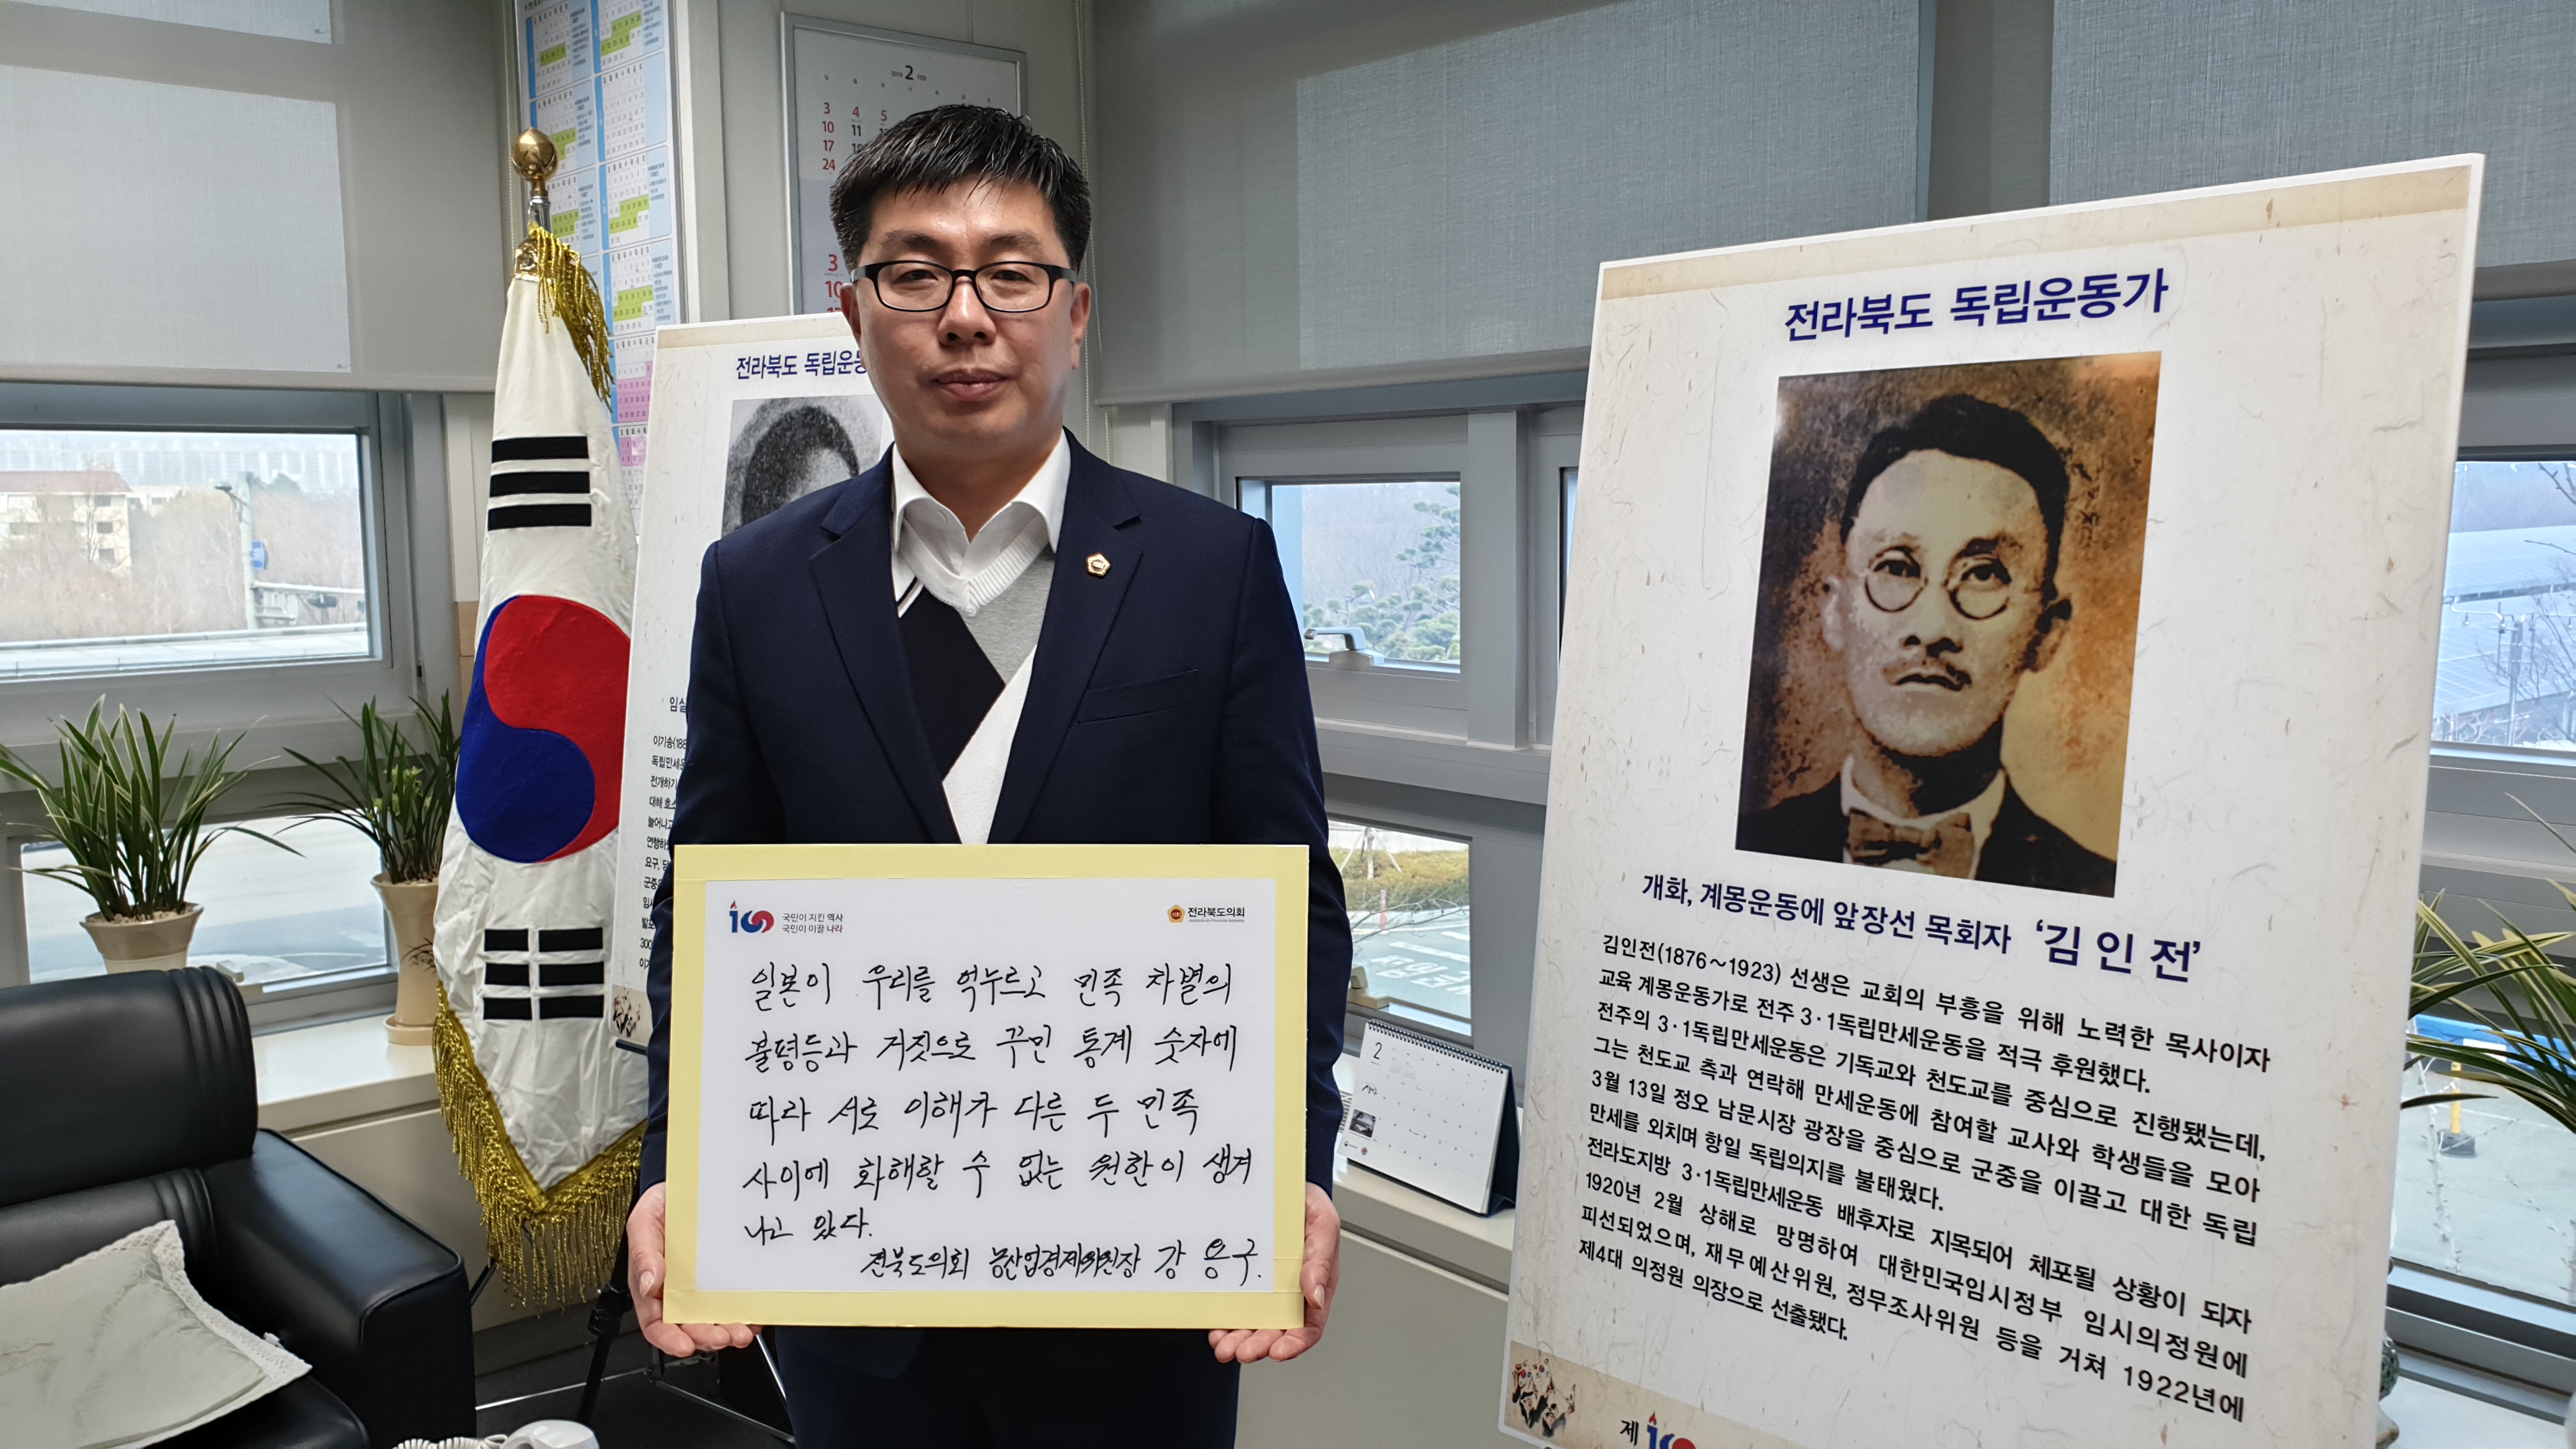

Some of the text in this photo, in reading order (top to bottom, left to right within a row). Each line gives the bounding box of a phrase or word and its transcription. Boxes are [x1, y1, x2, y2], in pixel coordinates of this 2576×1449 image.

[905, 65, 914, 80] 2
[822, 121, 861, 137] 10 11
[824, 102, 887, 121] 3 4 5
[822, 158, 836, 171] 24
[823, 140, 834, 152] 17
[829, 254, 838, 272] 3
[1785, 268, 2170, 342] 전라북도 독립운동가
[736, 354, 797, 380] 전라북도
[650, 797, 663, 809] 대해
[782, 924, 843, 933] 국민이 이끌 나라
[783, 913, 843, 922] 국민이 지킨 역사
[1188, 907, 1245, 917] 전라북도의회
[1642, 875, 1692, 907] 개화,
[1700, 884, 1824, 926] 계몽운동에
[1834, 901, 1915, 939] 앞장선
[1925, 915, 2011, 954] 목회자
[751, 962, 1231, 1012] 일본이 우리를 억누르고 민족 차별의
[1599, 969, 1632, 992] 교육
[1639, 975, 1749, 1014] 계몽운동가로
[1757, 999, 1794, 1023] 전주
[1997, 1044, 2042, 1072] 적극
[2051, 1053, 2150, 1093] 후원했다.
[1790, 968, 1850, 997] 선생은
[1860, 981, 1924, 1011] 교회의
[1936, 993, 2004, 1025] 부흥을
[2018, 1008, 2064, 1036] 위해
[2078, 1018, 2154, 1052] 노력한
[2166, 1032, 2271, 1073] 목사이자
[745, 1024, 1237, 1073] 불평등과 거짓으로 꾸민 통계 숫자에
[1373, 1042, 1382, 1059] 2
[1598, 1002, 1649, 1030] 전주의
[1836, 1052, 1916, 1086] 기독교와
[1926, 1069, 2012, 1107] 천도교를
[2025, 1089, 2117, 1127] 중심으로
[2133, 1111, 2265, 1162] 진행됐는데,
[750, 1088, 1199, 1146] 따라 서로 이해가 다른 두 민족
[1594, 1037, 2260, 1203] 그는 천도교 측과 연락해 만세운동에 참여할 교사와 학생들을 모아
[742, 1144, 1251, 1201] 사이에 화해할 수 없는 원한이 생겨
[1590, 1103, 1943, 1211] 만세를 외치며 항일 독립의지를 불태웠다.
[1592, 1070, 2257, 1246] 3월 13일 정오 남문시장 광장을 중심으로 군중을 이끌고 대한 독립
[744, 1215, 793, 1246] 나고
[1588, 1137, 1671, 1176] 전라도지방
[1837, 1204, 1915, 1241] 배후자로
[1930, 1229, 2012, 1269] 지목되어
[2028, 1254, 2096, 1292] 체포될
[2112, 1276, 2185, 1317] 상황이
[2201, 1300, 2252, 1334] 되자
[860, 1246, 969, 1280] 전북도의회
[1586, 1172, 2248, 1378] 1920년 2월 상해로 망명하여 대한민국임시정부 임시의정원에
[1579, 1239, 1847, 1340] 제4대 의정원 의장으로 선출됐다.
[1581, 1206, 2244, 1422] 피선되었으며, 재무예산위원, 정무조사위원 등을 거쳐 1922년에
[1620, 1420, 1639, 1446] 제
